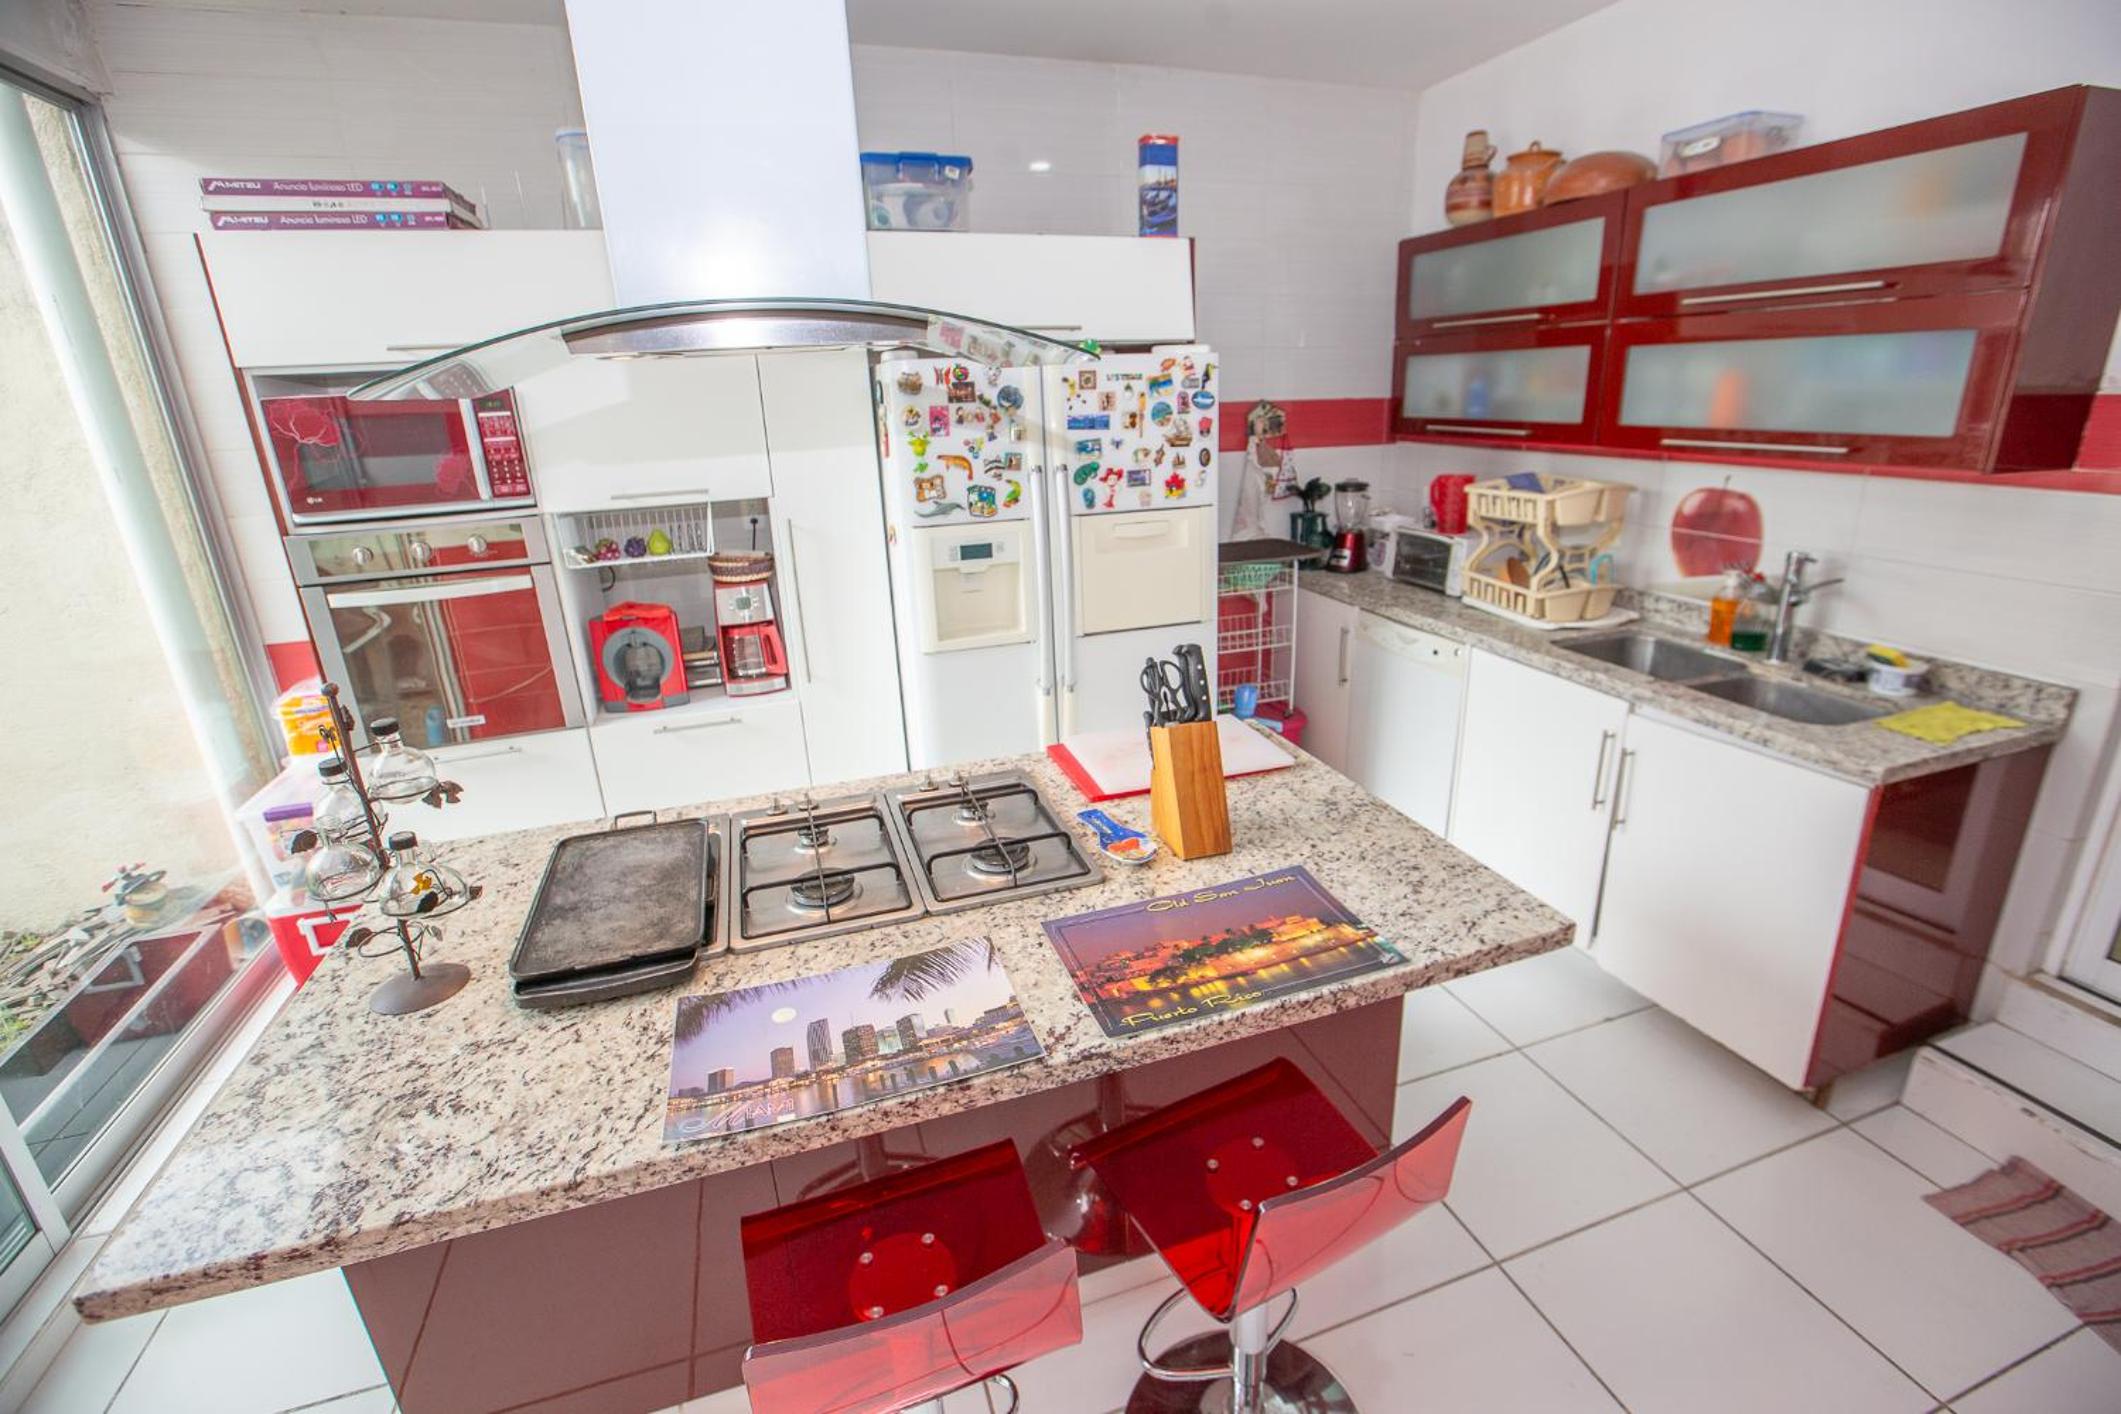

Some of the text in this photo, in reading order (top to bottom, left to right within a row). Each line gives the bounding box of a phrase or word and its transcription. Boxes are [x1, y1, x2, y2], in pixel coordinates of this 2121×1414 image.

[273, 182, 308, 191] Anuncio
[346, 183, 364, 192] LED
[280, 216, 313, 225] Anuncio
[351, 214, 369, 224] LED
[1147, 875, 1297, 912] Old San Juan
[1120, 990, 1262, 1027] Puerto Rico
